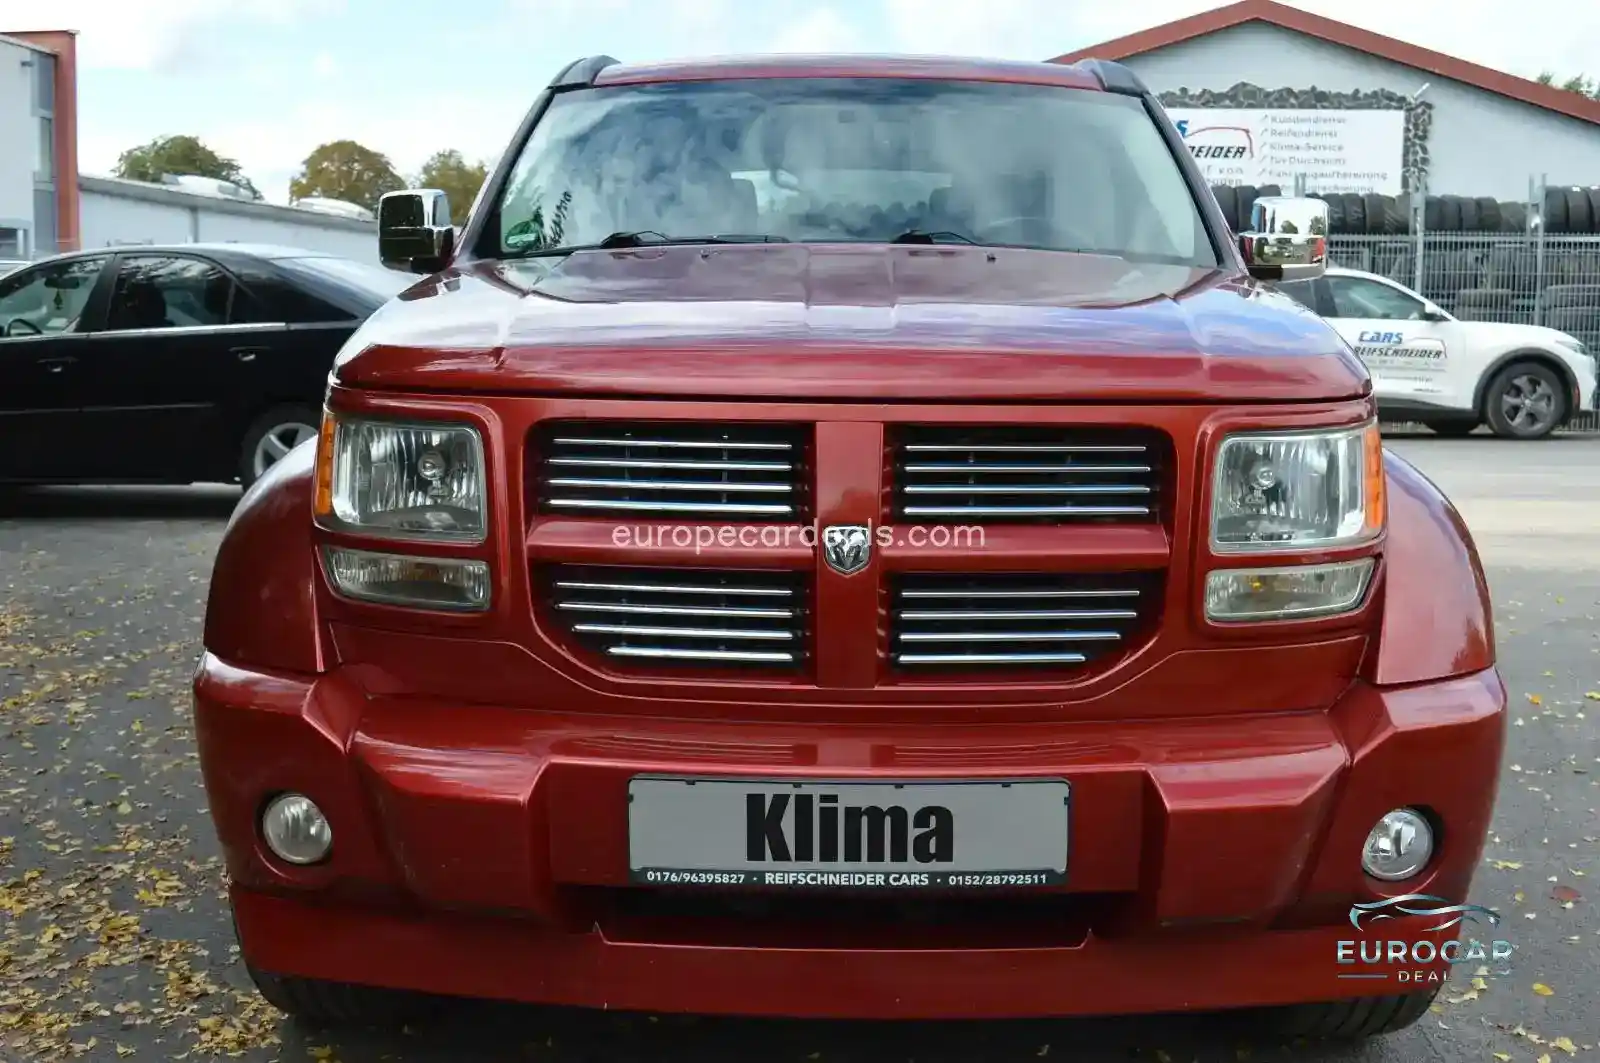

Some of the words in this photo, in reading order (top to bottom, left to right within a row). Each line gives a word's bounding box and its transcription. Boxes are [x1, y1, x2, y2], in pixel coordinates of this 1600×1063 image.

[746, 793, 954, 864] Klima
[647, 871, 745, 884] 0176/96395827
[765, 873, 884, 886] REIFSCHNEIDER
[889, 874, 929, 886] CARS
[948, 874, 1047, 886] 0152/28792511
